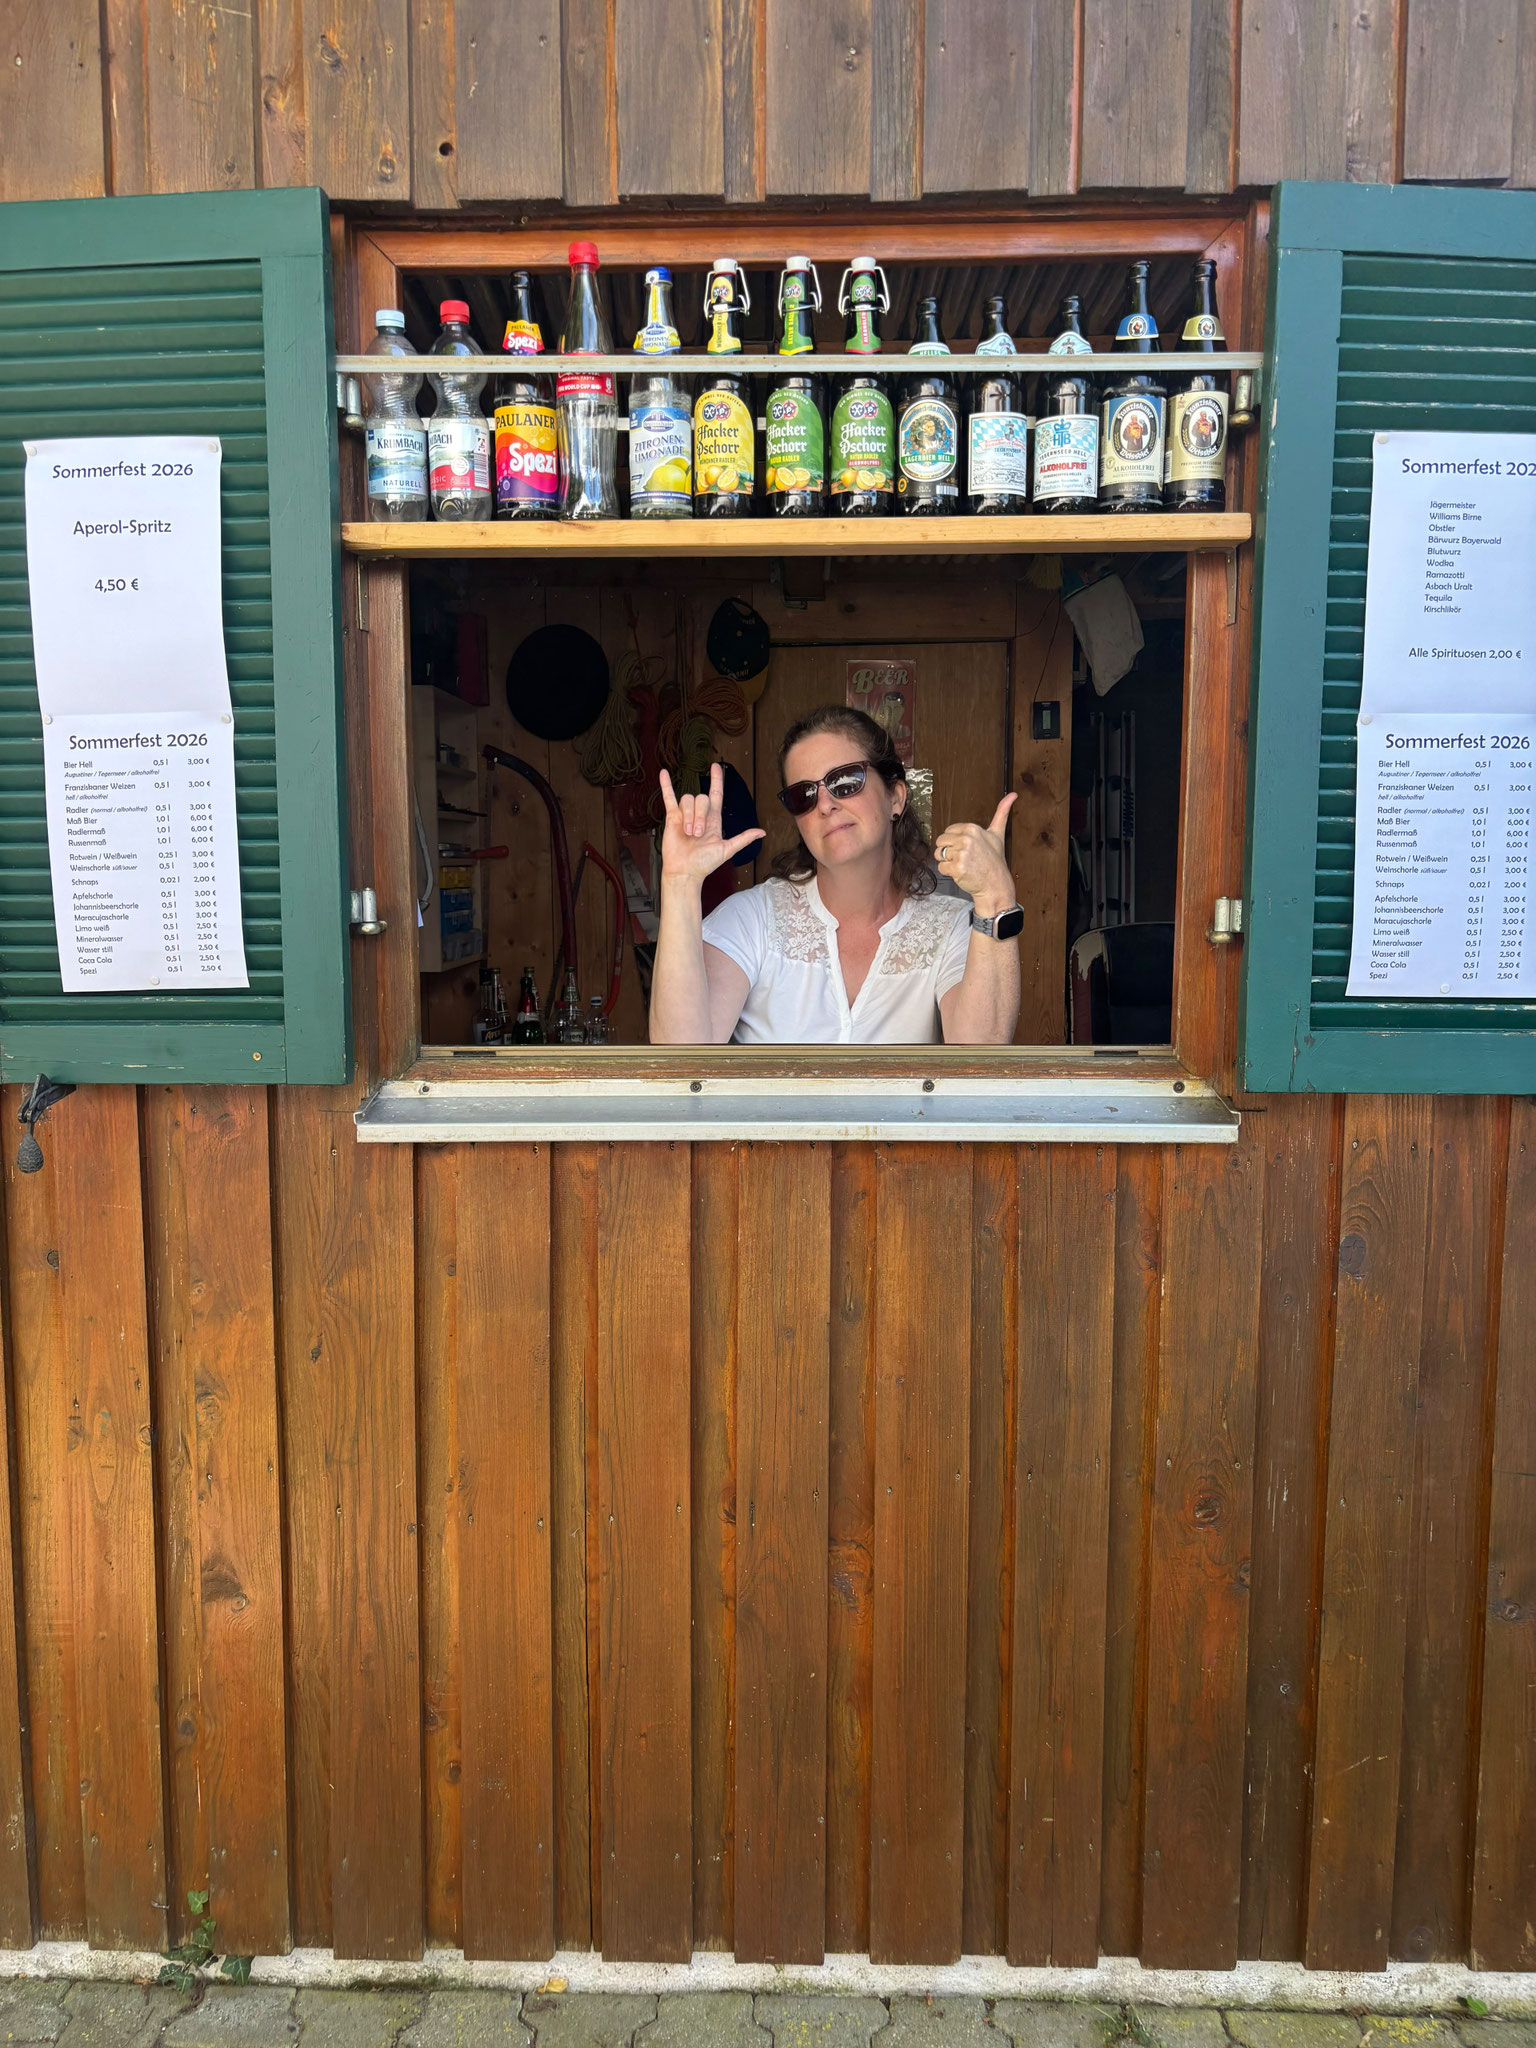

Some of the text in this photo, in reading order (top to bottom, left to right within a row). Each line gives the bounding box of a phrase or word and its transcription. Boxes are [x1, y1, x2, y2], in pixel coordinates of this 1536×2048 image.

[507, 332, 537, 350] Spezi
[496, 414, 555, 429] PAULANER
[697, 425, 739, 442] Hacker
[767, 422, 807, 440] Hacker
[841, 422, 886, 440] Hacker
[377, 438, 423, 452] KRUMBACH
[696, 440, 740, 459] Pschorr
[767, 438, 807, 459] Pschorr
[840, 438, 887, 458] Pschorr
[509, 442, 556, 476] Spezi
[634, 446, 684, 463] LIMONADE
[904, 455, 936, 463] LAGERBIER
[52, 461, 193, 479] Sommerfest 2026
[1040, 462, 1087, 473] ALKOHOLFREI
[1402, 458, 1536, 476] Sommerfest 202
[1430, 501, 1476, 510] Jägermeister
[1430, 512, 1460, 521] Williams
[73, 519, 172, 537] Aperol-Spritz
[1429, 524, 1455, 532] Obstler
[1462, 536, 1501, 546] Bayerwald
[1427, 548, 1461, 556] Blutwurz
[1427, 559, 1454, 567] Wodka
[1426, 571, 1465, 579] Ramazotti
[95, 578, 139, 593] 4,50 €
[1454, 582, 1473, 590] Uralt
[1425, 594, 1452, 602] Tequila
[1424, 605, 1461, 613] Kirschlikör
[1409, 648, 1522, 660] Alle Spirituosen 2,00 €
[852, 668, 909, 694] BEER
[69, 733, 208, 750] Sommerfest 2026
[1386, 733, 1530, 749] Sommerfest 2026
[1375, 895, 1418, 903] Apfelschorle
[73, 902, 139, 911] Johannisbeerschorle
[74, 914, 129, 922] Maracujaschorle
[1374, 917, 1432, 926] Maracujaschorle
